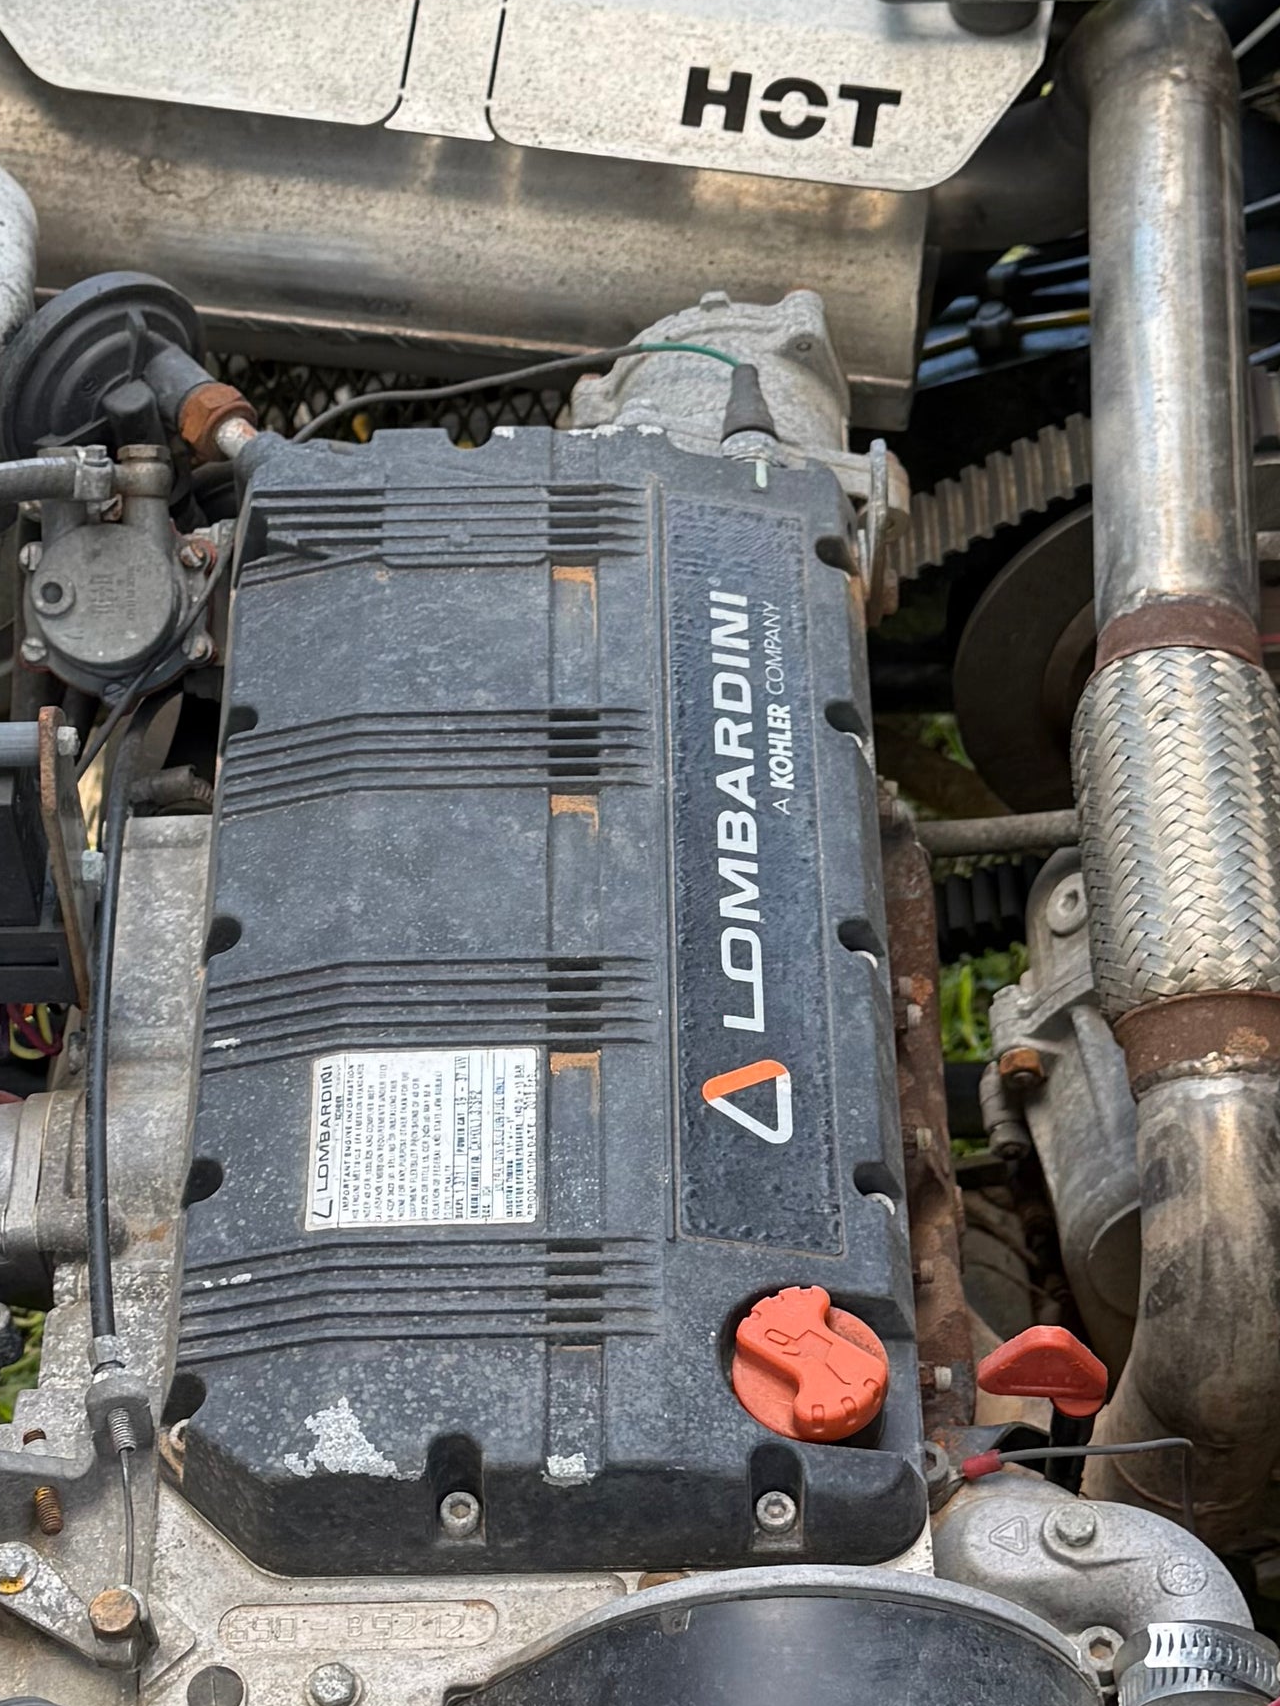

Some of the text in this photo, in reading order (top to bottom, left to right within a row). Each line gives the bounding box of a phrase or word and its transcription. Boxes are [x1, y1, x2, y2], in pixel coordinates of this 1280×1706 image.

[680, 66, 903, 149] HOT
[761, 600, 796, 816] A KOHLER COMPANY
[708, 590, 766, 1034] LOMBARDINI
[316, 1065, 333, 1193] LOMBARDINI
